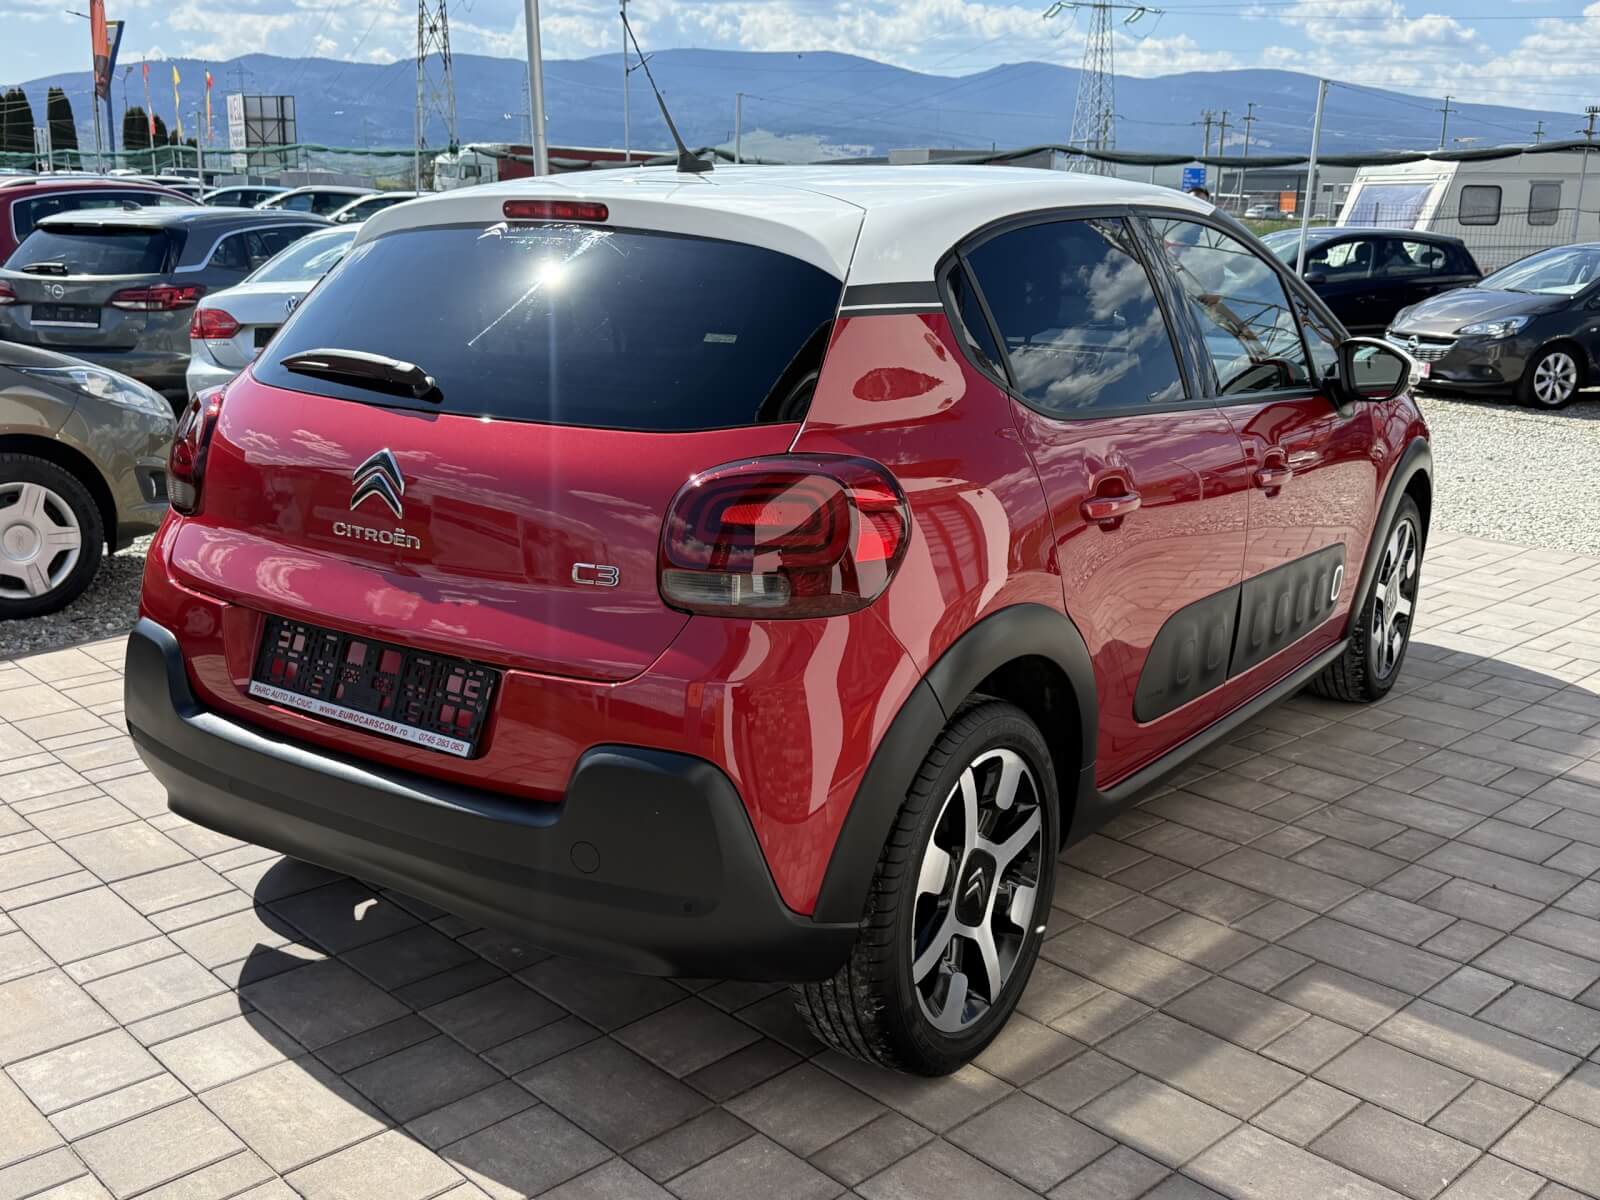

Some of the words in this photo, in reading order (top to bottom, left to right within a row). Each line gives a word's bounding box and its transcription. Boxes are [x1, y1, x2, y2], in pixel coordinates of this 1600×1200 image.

[571, 562, 620, 587] C3
[254, 684, 271, 697] PARC
[272, 689, 289, 702] AUTO
